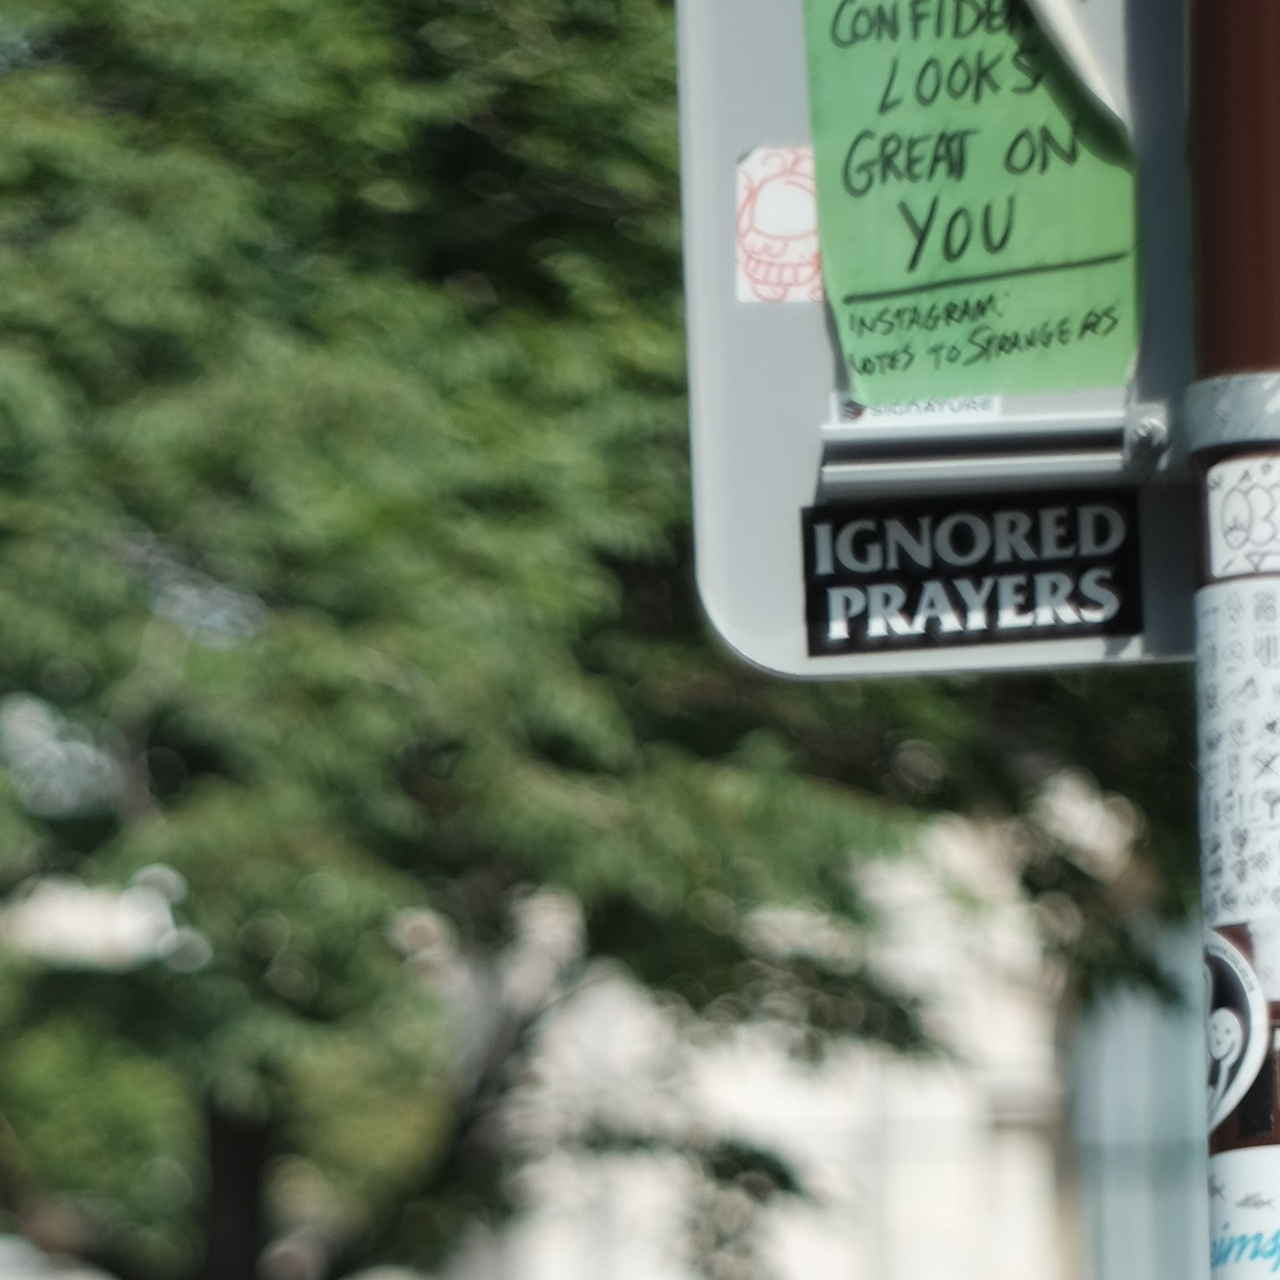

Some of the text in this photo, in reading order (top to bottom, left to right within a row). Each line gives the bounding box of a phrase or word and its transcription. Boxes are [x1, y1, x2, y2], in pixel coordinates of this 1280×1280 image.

[877, 48, 1045, 116] LOOKS
[841, 124, 1081, 198] GREAT ON
[896, 195, 1016, 273] YOU
[926, 343, 962, 371] TO
[814, 504, 1126, 577] IGNORED
[826, 567, 1121, 641] PRAYERS
